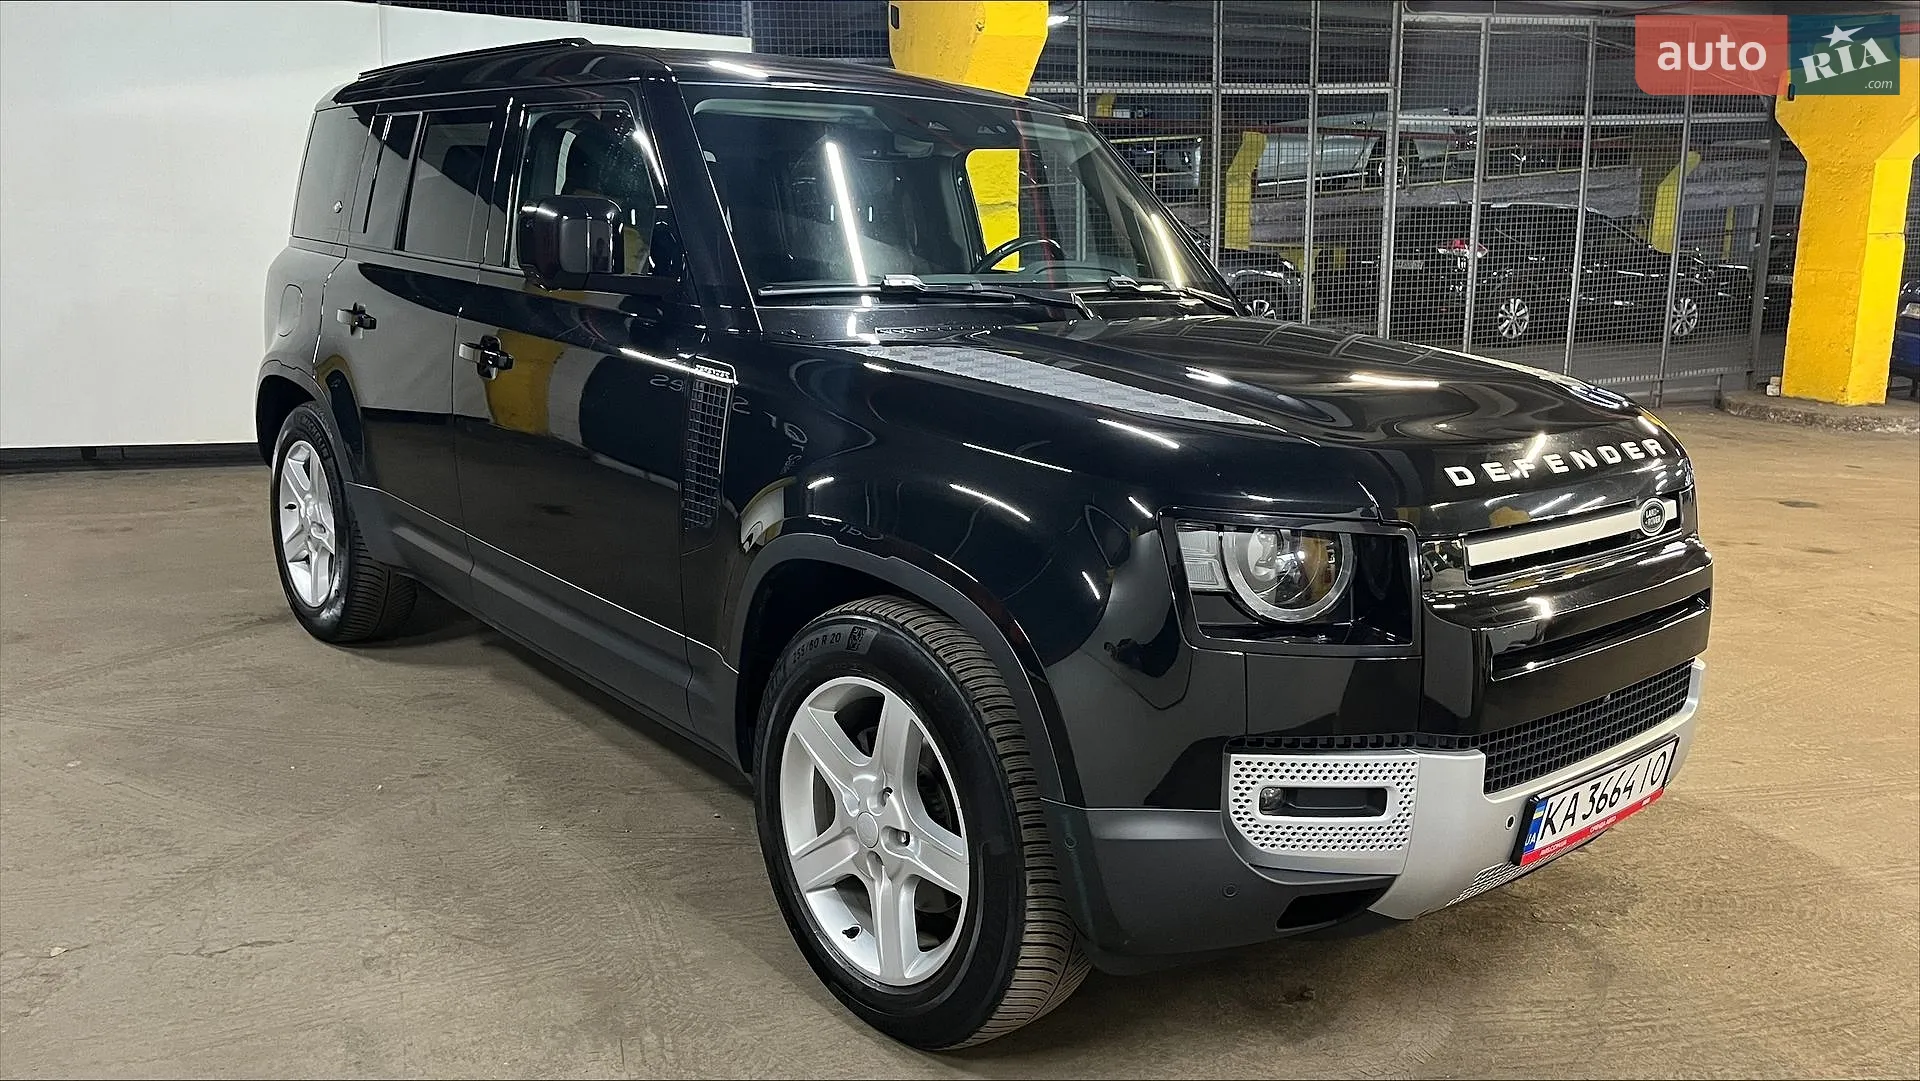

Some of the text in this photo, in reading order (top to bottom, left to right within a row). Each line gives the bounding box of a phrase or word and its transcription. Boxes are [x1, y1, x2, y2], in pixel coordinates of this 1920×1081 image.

[1444, 438, 1667, 487] DEFENDER
[830, 632, 842, 644] 20
[1525, 832, 1537, 845] UA
